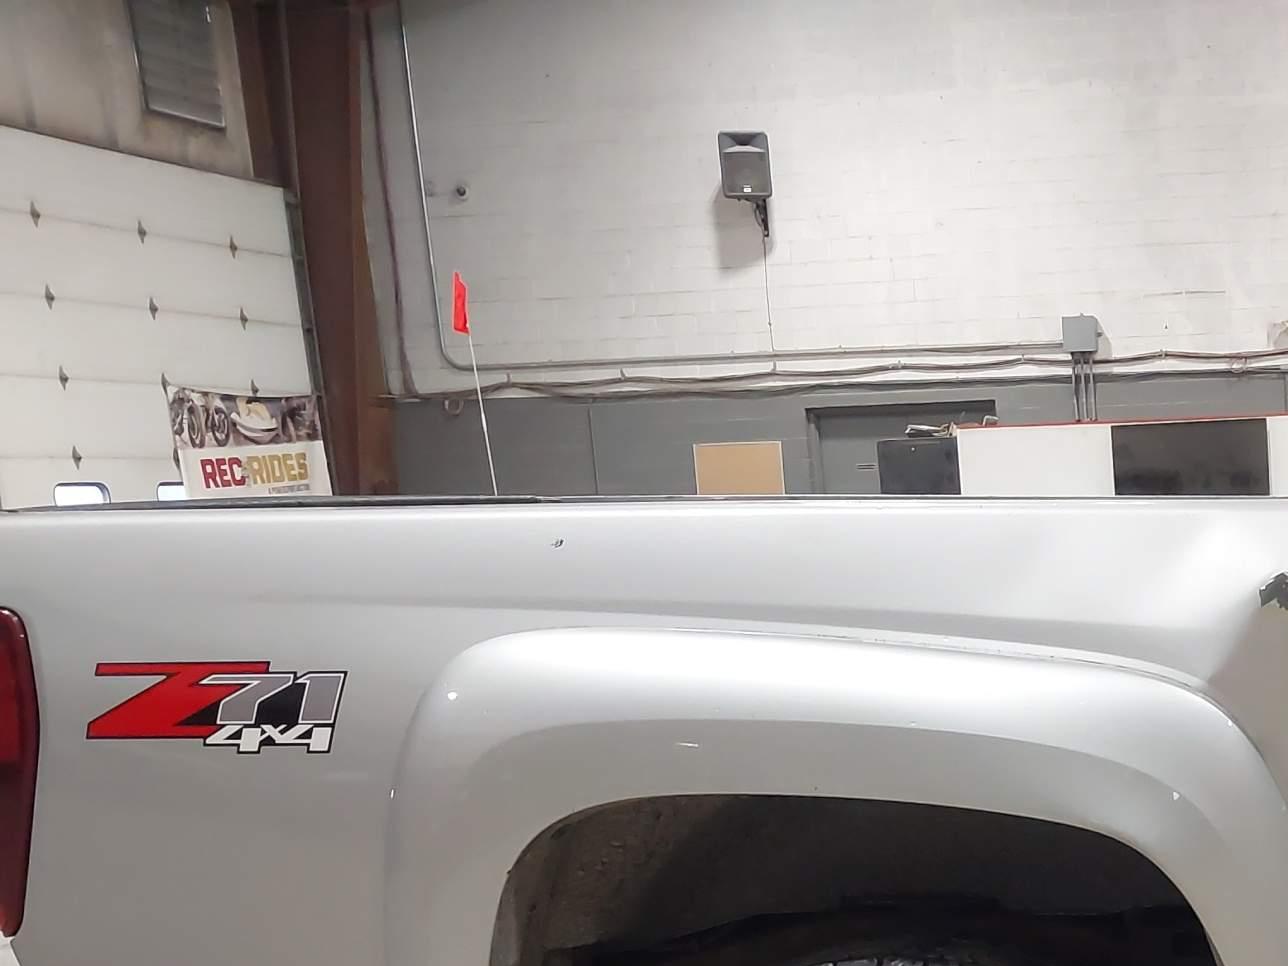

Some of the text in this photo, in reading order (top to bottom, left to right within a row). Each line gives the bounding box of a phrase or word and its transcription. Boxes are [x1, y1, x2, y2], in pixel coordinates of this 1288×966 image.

[200, 452, 309, 489] REC RIDES
[86, 661, 347, 740] Z71
